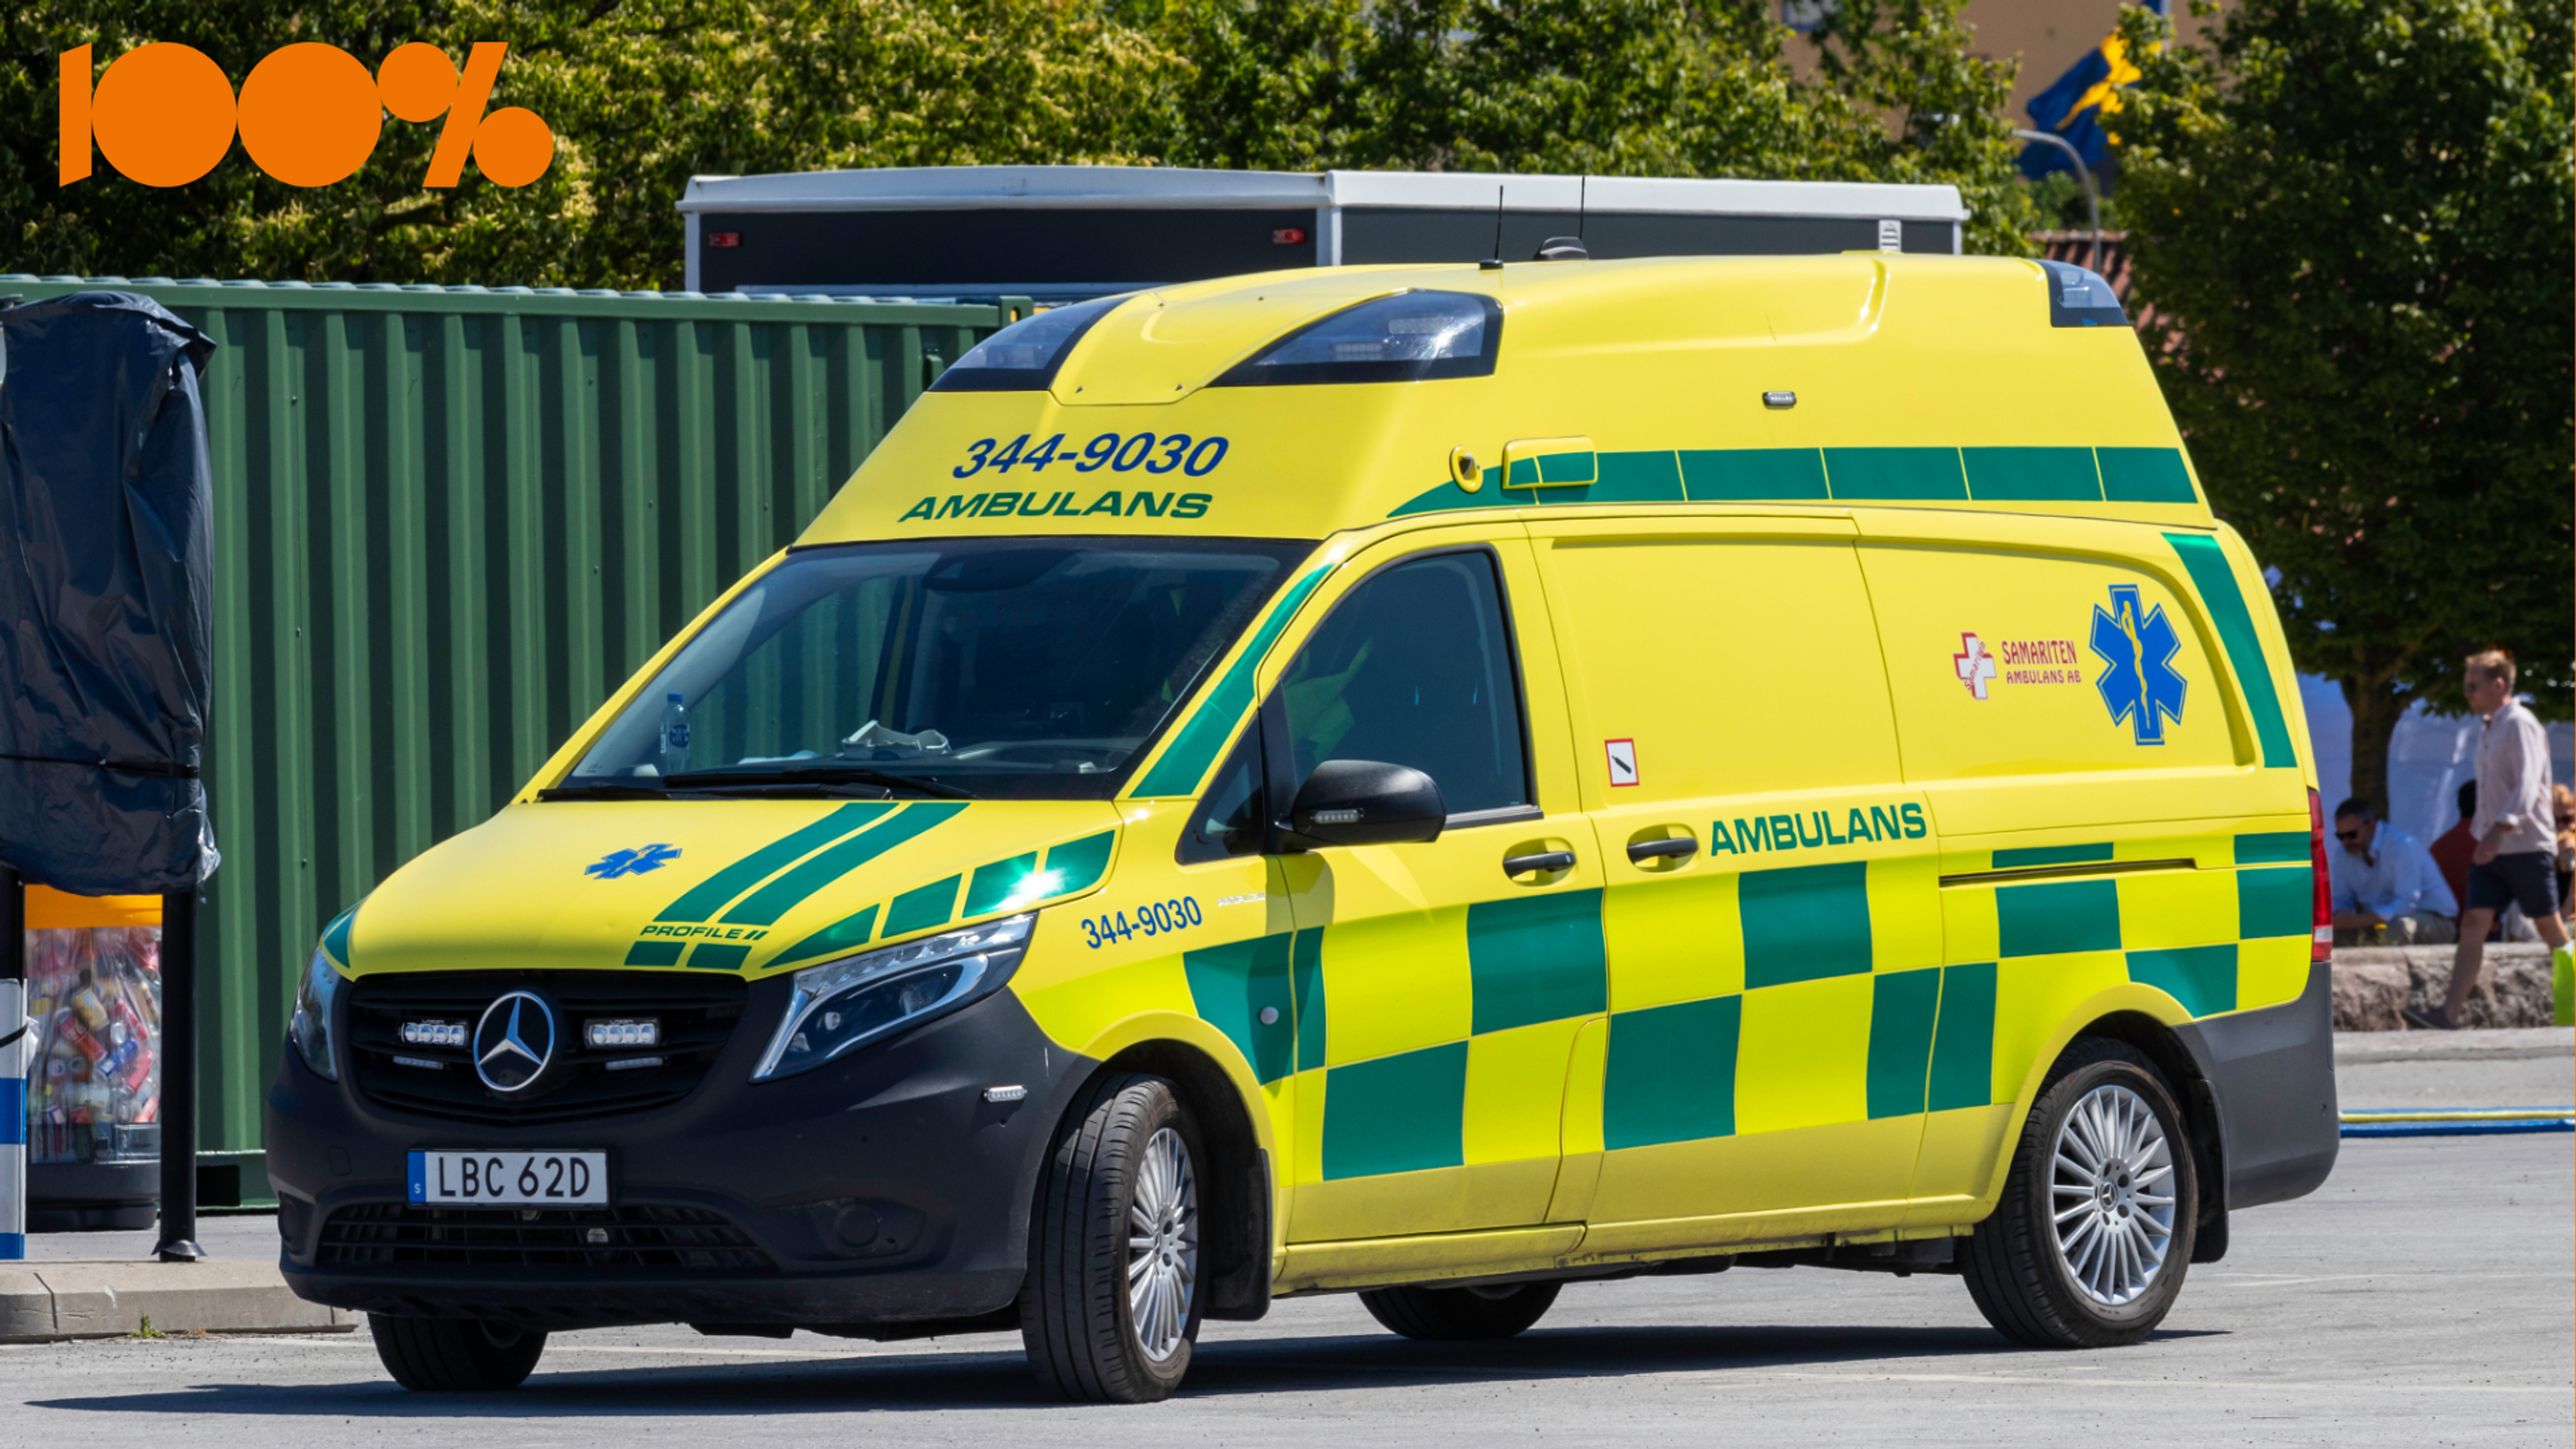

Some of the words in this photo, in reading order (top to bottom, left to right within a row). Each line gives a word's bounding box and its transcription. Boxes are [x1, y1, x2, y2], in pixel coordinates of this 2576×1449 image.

[953, 432, 1230, 479] 344-9030
[897, 491, 1214, 523] AMBULANS
[2001, 640, 2078, 665] SAMARITEN
[2006, 669, 2065, 684] AMBULANS
[2067, 669, 2082, 684] AB
[1711, 802, 1927, 857] AMBULANS
[639, 926, 744, 939] PROFILE
[1081, 896, 1203, 950] 344-9030
[414, 1183, 421, 1194] S
[438, 1157, 504, 1197] LBC
[517, 1157, 590, 1197] 62D
